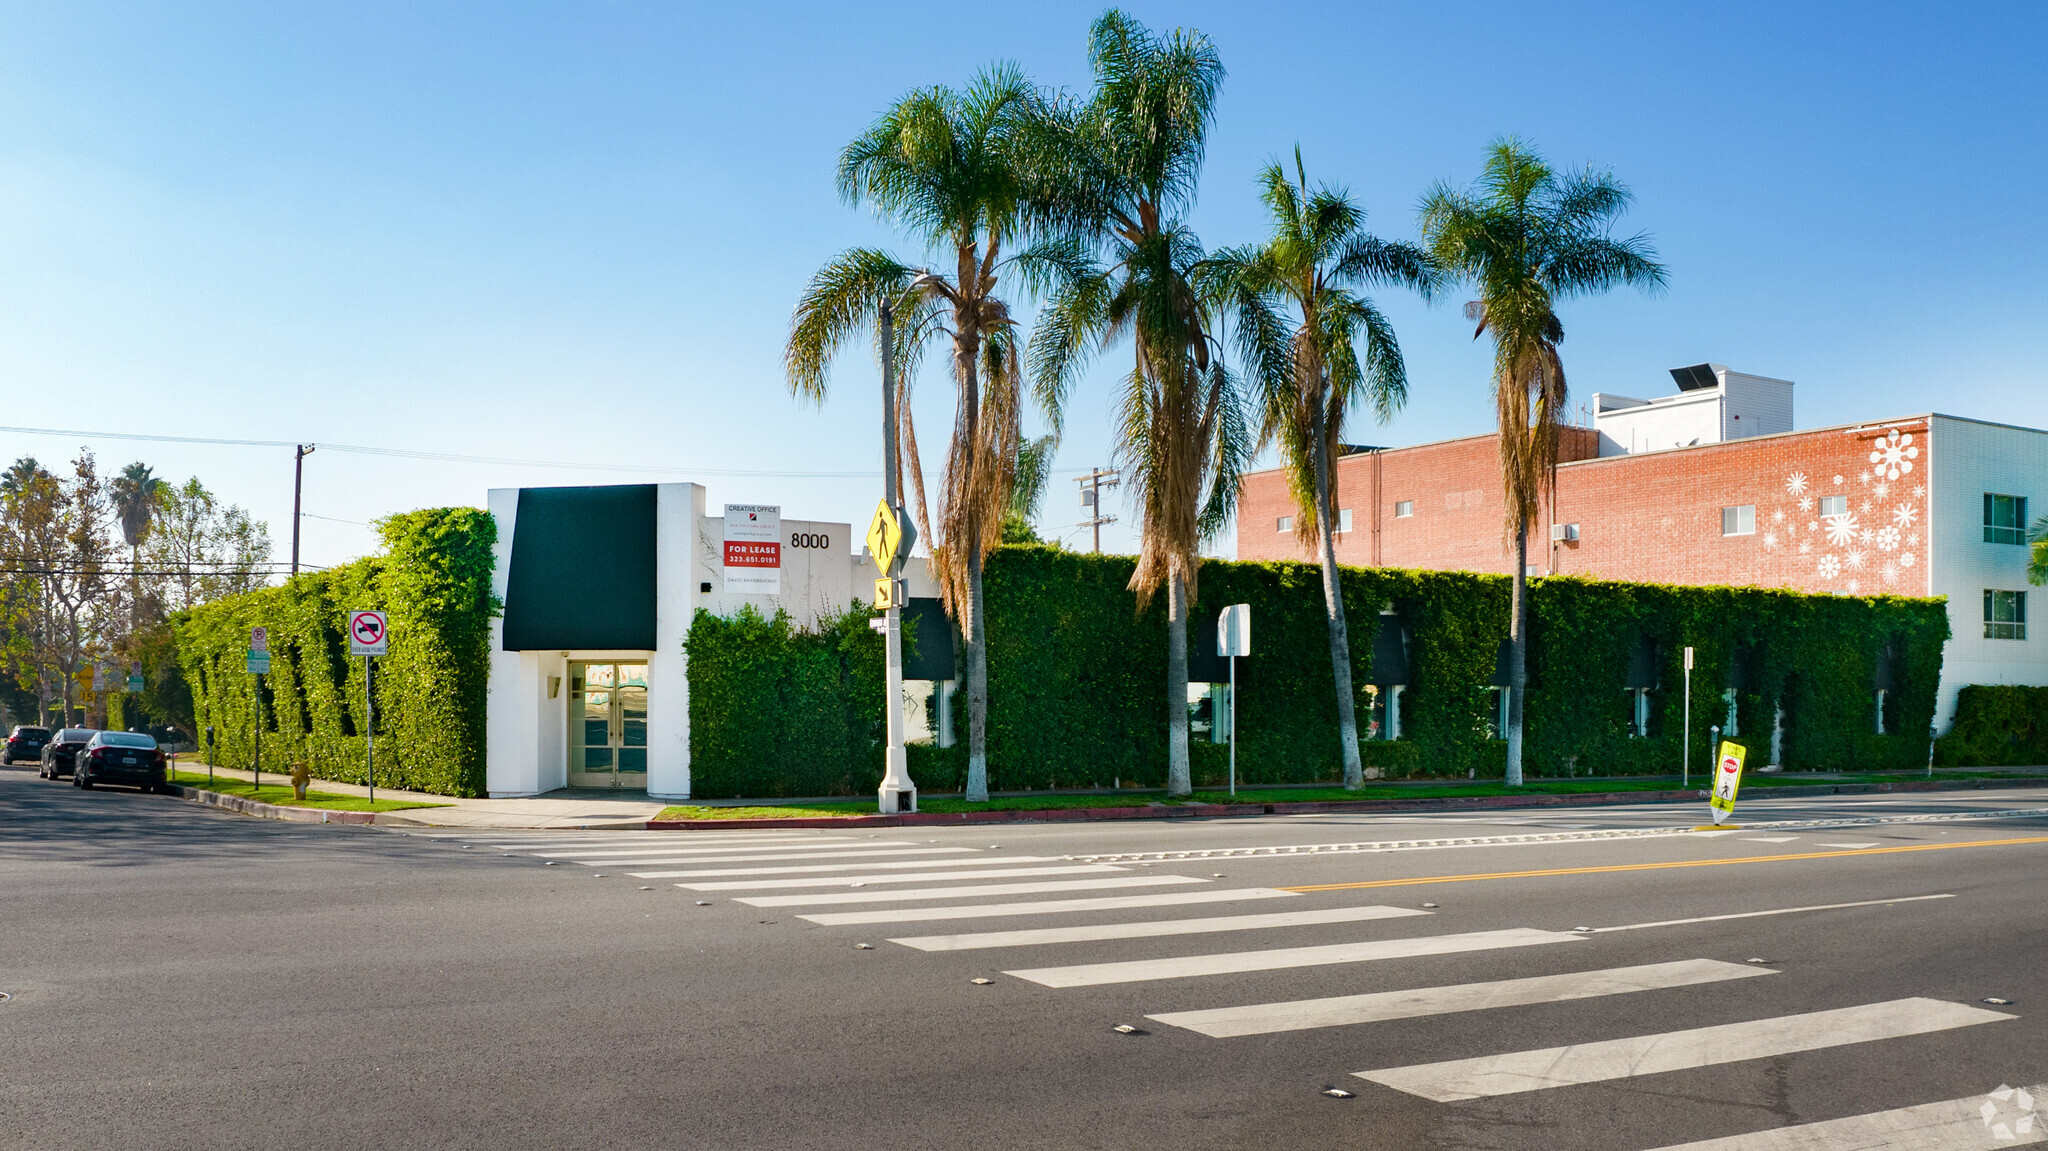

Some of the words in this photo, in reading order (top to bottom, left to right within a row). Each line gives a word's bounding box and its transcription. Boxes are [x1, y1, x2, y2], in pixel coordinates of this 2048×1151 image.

[791, 532, 829, 549] 8000
[729, 545, 747, 553] FOR
[749, 546, 776, 554] LEASE
[729, 555, 776, 563] 323.651.0191
[82, 692, 93, 702] 15
[1723, 761, 1738, 771] STOP
